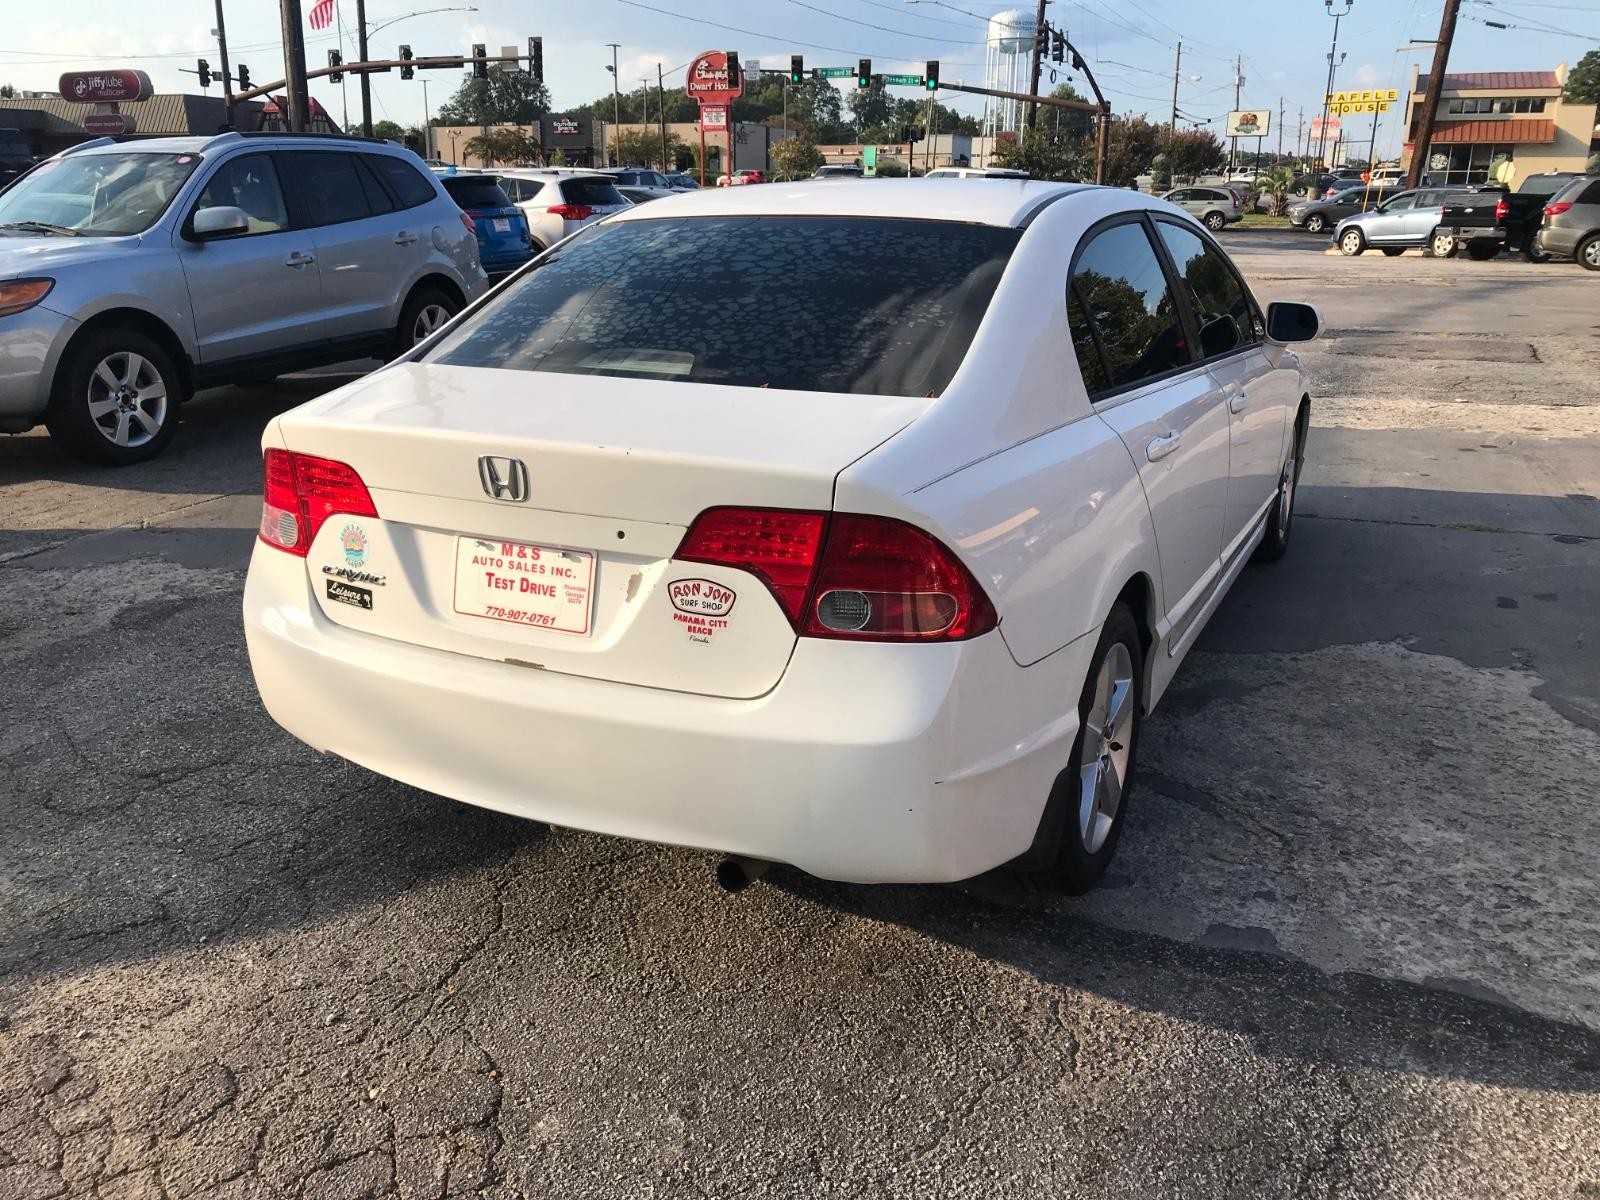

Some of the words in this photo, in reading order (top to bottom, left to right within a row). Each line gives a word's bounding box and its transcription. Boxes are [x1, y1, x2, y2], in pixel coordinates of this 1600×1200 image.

[88, 76, 106, 91] jiffy
[105, 76, 123, 87] lube
[690, 82, 713, 91] Dwarf
[714, 82, 729, 91] Hou
[1330, 103, 1388, 113] HOUSE
[501, 543, 513, 557] M
[516, 546, 526, 559] &
[531, 547, 542, 560] S
[472, 555, 504, 568] AUTO
[508, 561, 546, 574] SALES
[551, 566, 577, 579] INC.
[328, 582, 362, 600] Leisure
[565, 591, 585, 601] Georgia
[673, 582, 701, 599] RON
[703, 586, 732, 604] JON
[680, 598, 699, 607] SURF
[702, 601, 723, 611] SHOP
[485, 605, 557, 626] 770-907-0761
[673, 613, 706, 626] PANAMA
[708, 619, 728, 628] CITY
[687, 625, 713, 636] BEACH
